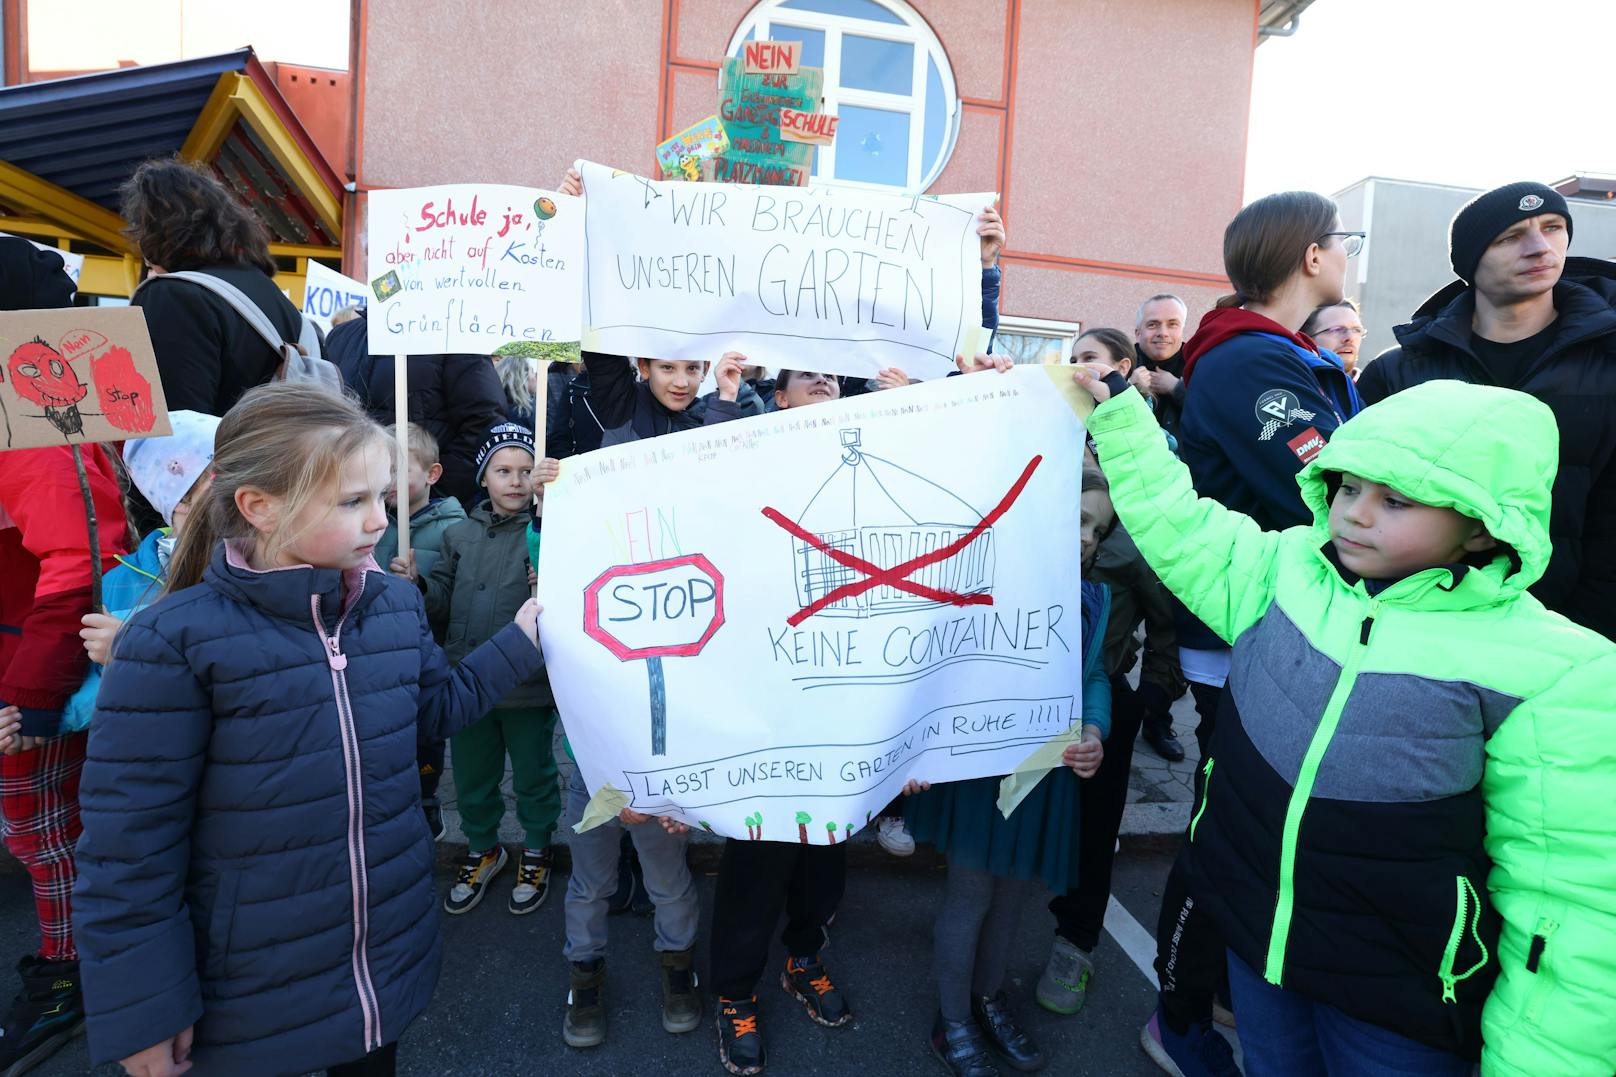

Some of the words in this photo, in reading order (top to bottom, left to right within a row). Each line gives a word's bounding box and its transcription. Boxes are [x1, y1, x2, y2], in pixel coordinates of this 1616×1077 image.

[745, 41, 793, 70] NEIN
[762, 74, 788, 90] ZUR
[782, 109, 840, 137] SCHULE
[415, 194, 487, 232] Schule
[497, 206, 531, 238] ja,
[671, 188, 727, 226] WIR
[751, 195, 930, 261] BRAUCHEN
[385, 240, 415, 265] aber
[424, 235, 456, 262] nicht
[467, 236, 494, 271] auf
[500, 241, 566, 271] Kosten
[403, 279, 424, 292] von
[435, 266, 526, 292] wertvollen
[616, 252, 736, 298] UNSEREN
[757, 243, 934, 331] GARTEN
[63, 334, 91, 354] Nein
[386, 298, 556, 353] Grünflächen
[1295, 436, 1319, 457] DMV
[608, 578, 716, 621] STOP
[768, 626, 862, 667] KEINE
[883, 604, 1070, 667] CONTAINER
[645, 768, 715, 796] LASST
[728, 760, 823, 788] UNSEREN
[840, 736, 914, 783] GARTEN
[921, 722, 940, 741] IN
[953, 713, 1017, 735] RUHE
